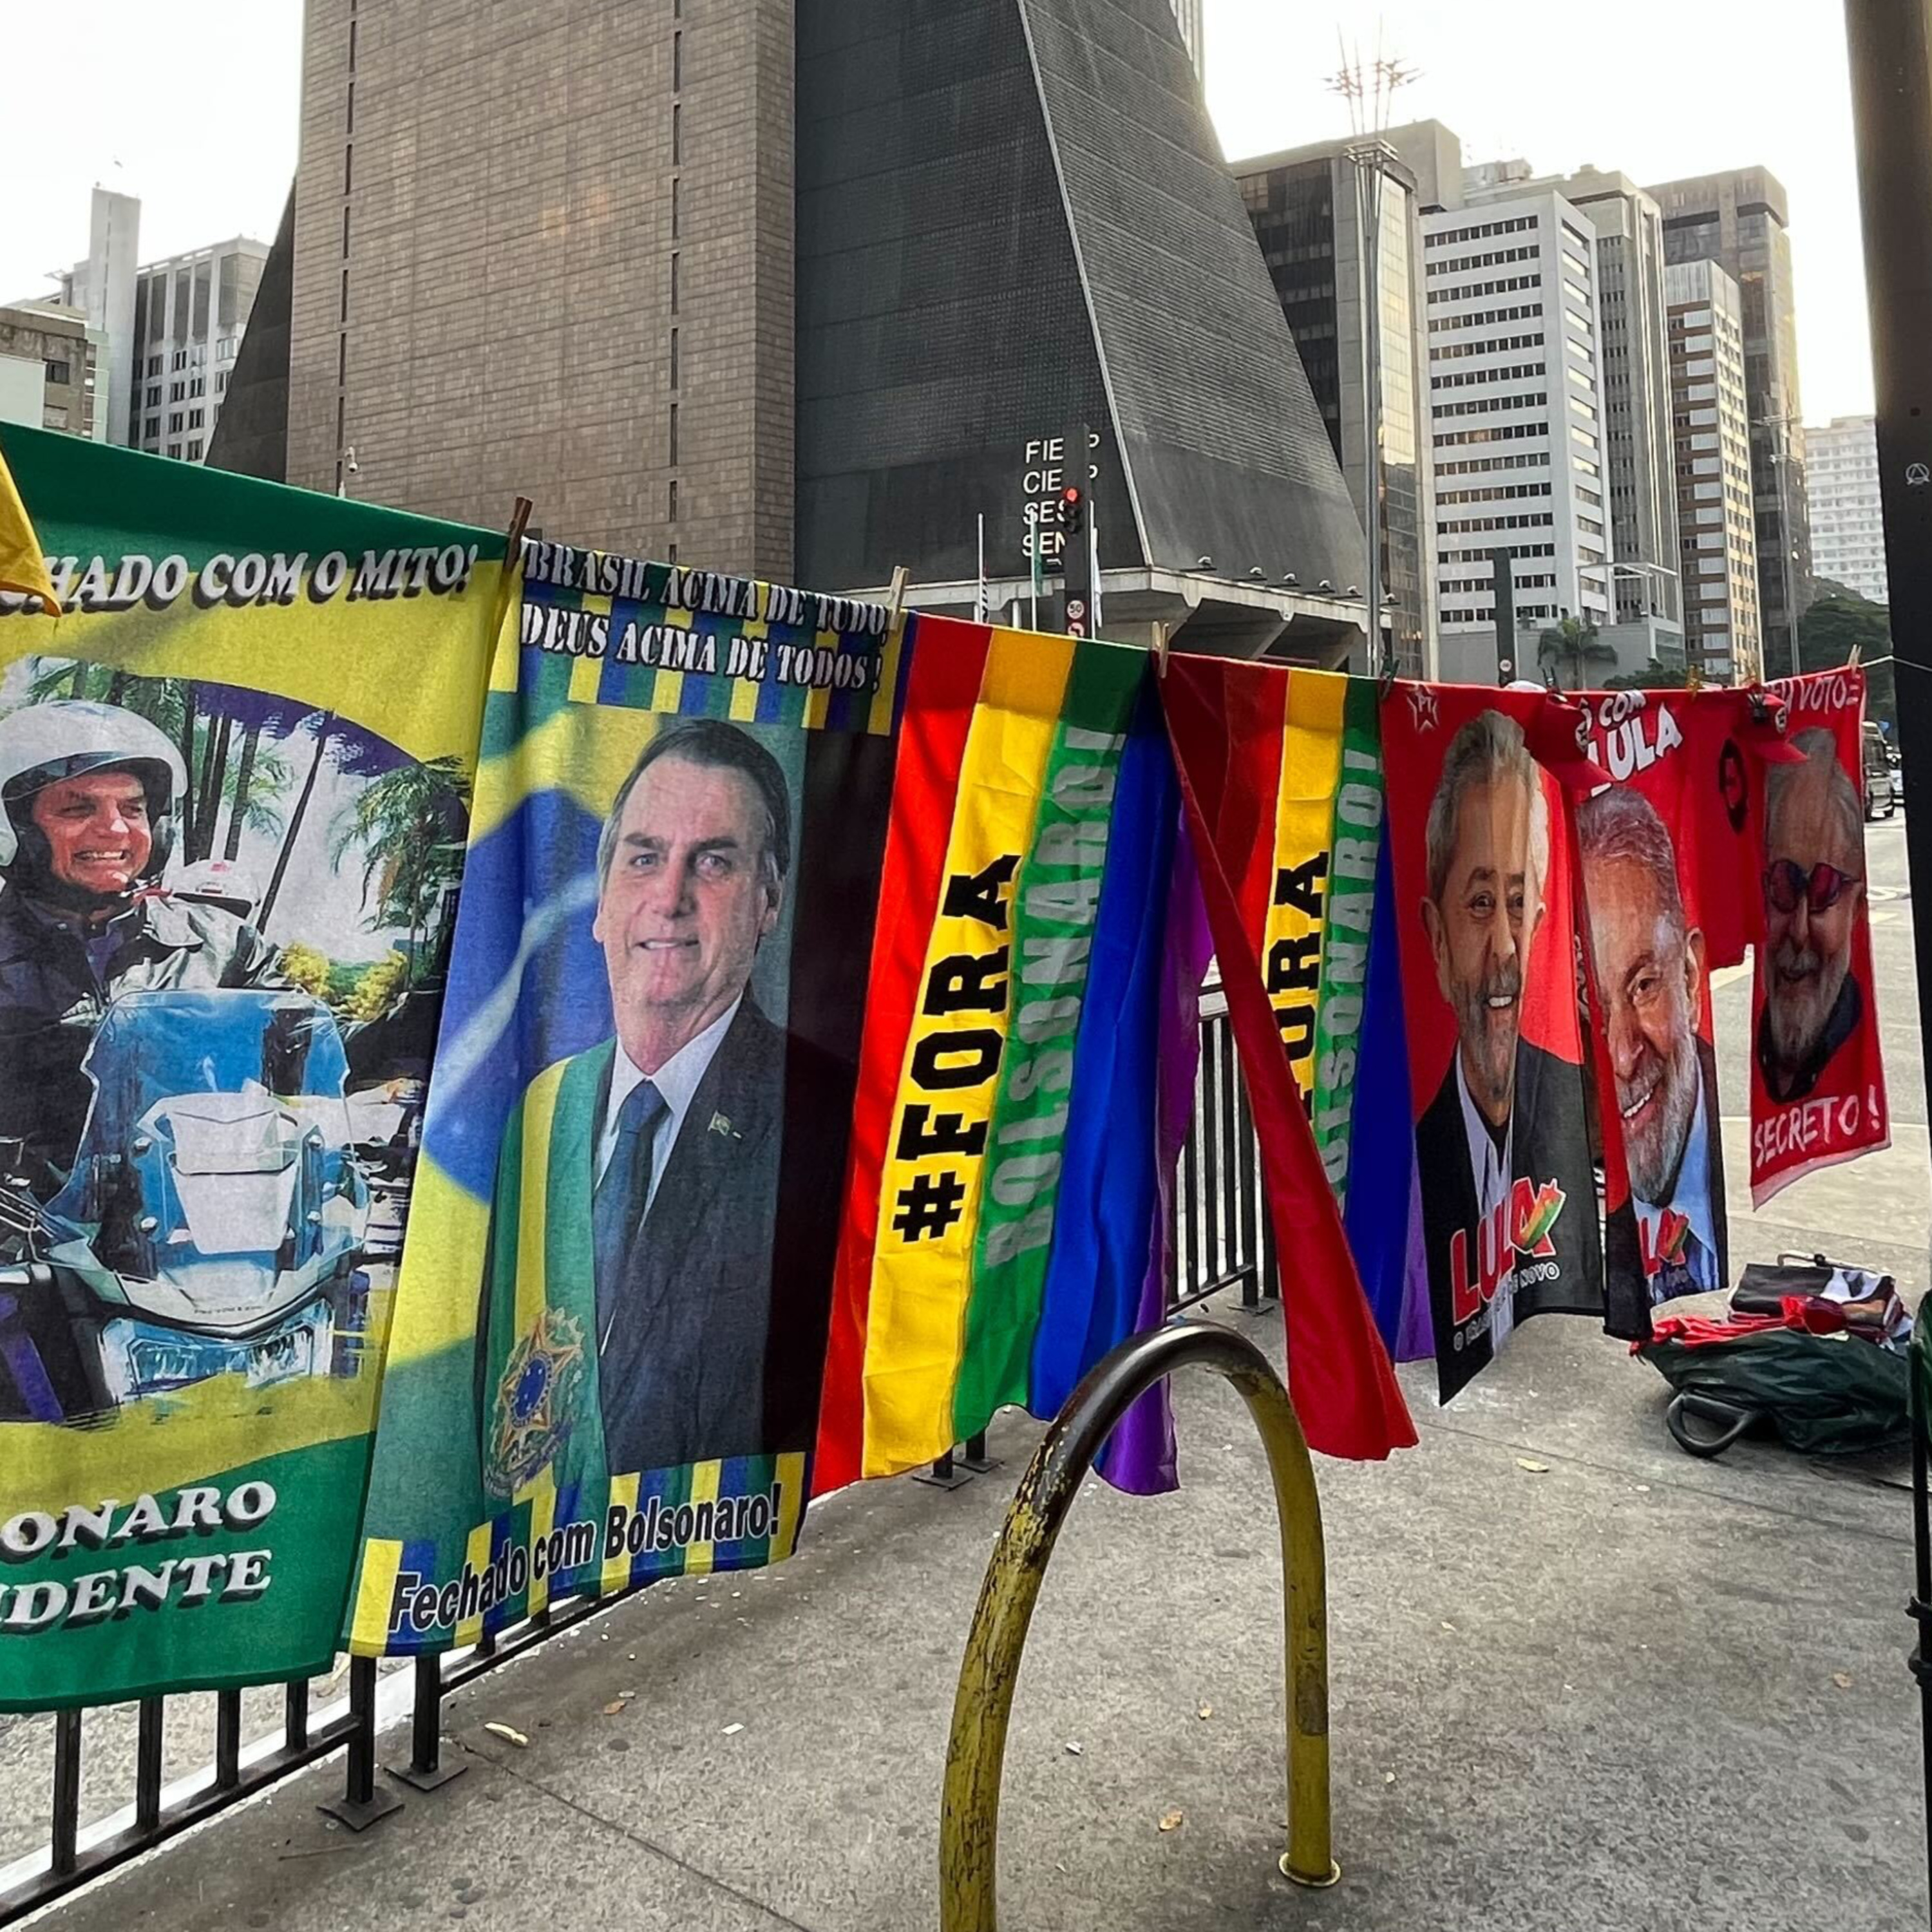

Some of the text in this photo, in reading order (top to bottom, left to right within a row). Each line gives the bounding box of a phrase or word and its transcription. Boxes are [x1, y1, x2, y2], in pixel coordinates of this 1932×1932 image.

[198, 553, 308, 605] COM
[310, 551, 347, 599] O
[354, 545, 478, 598] MITO!
[525, 541, 650, 600] BRASIL
[662, 567, 757, 620] ACIMA
[766, 583, 806, 625] DE
[1070, 603, 1083, 613] 50
[522, 603, 609, 656] DEUS
[616, 623, 716, 674] ACIMA
[726, 637, 769, 679] DE
[1418, 694, 1432, 713] PT
[1599, 690, 1647, 726] COM
[1798, 675, 1847, 715] VOTO
[986, 726, 1126, 1269] BOLSONARO!
[1267, 851, 1329, 1121] ORA
[1318, 748, 1385, 1217] OLSONARO!
[893, 854, 1022, 1244] #FORA
[1451, 1176, 1558, 1326] LULA
[389, 1482, 781, 1633] Fechado com Bolsonaro!
